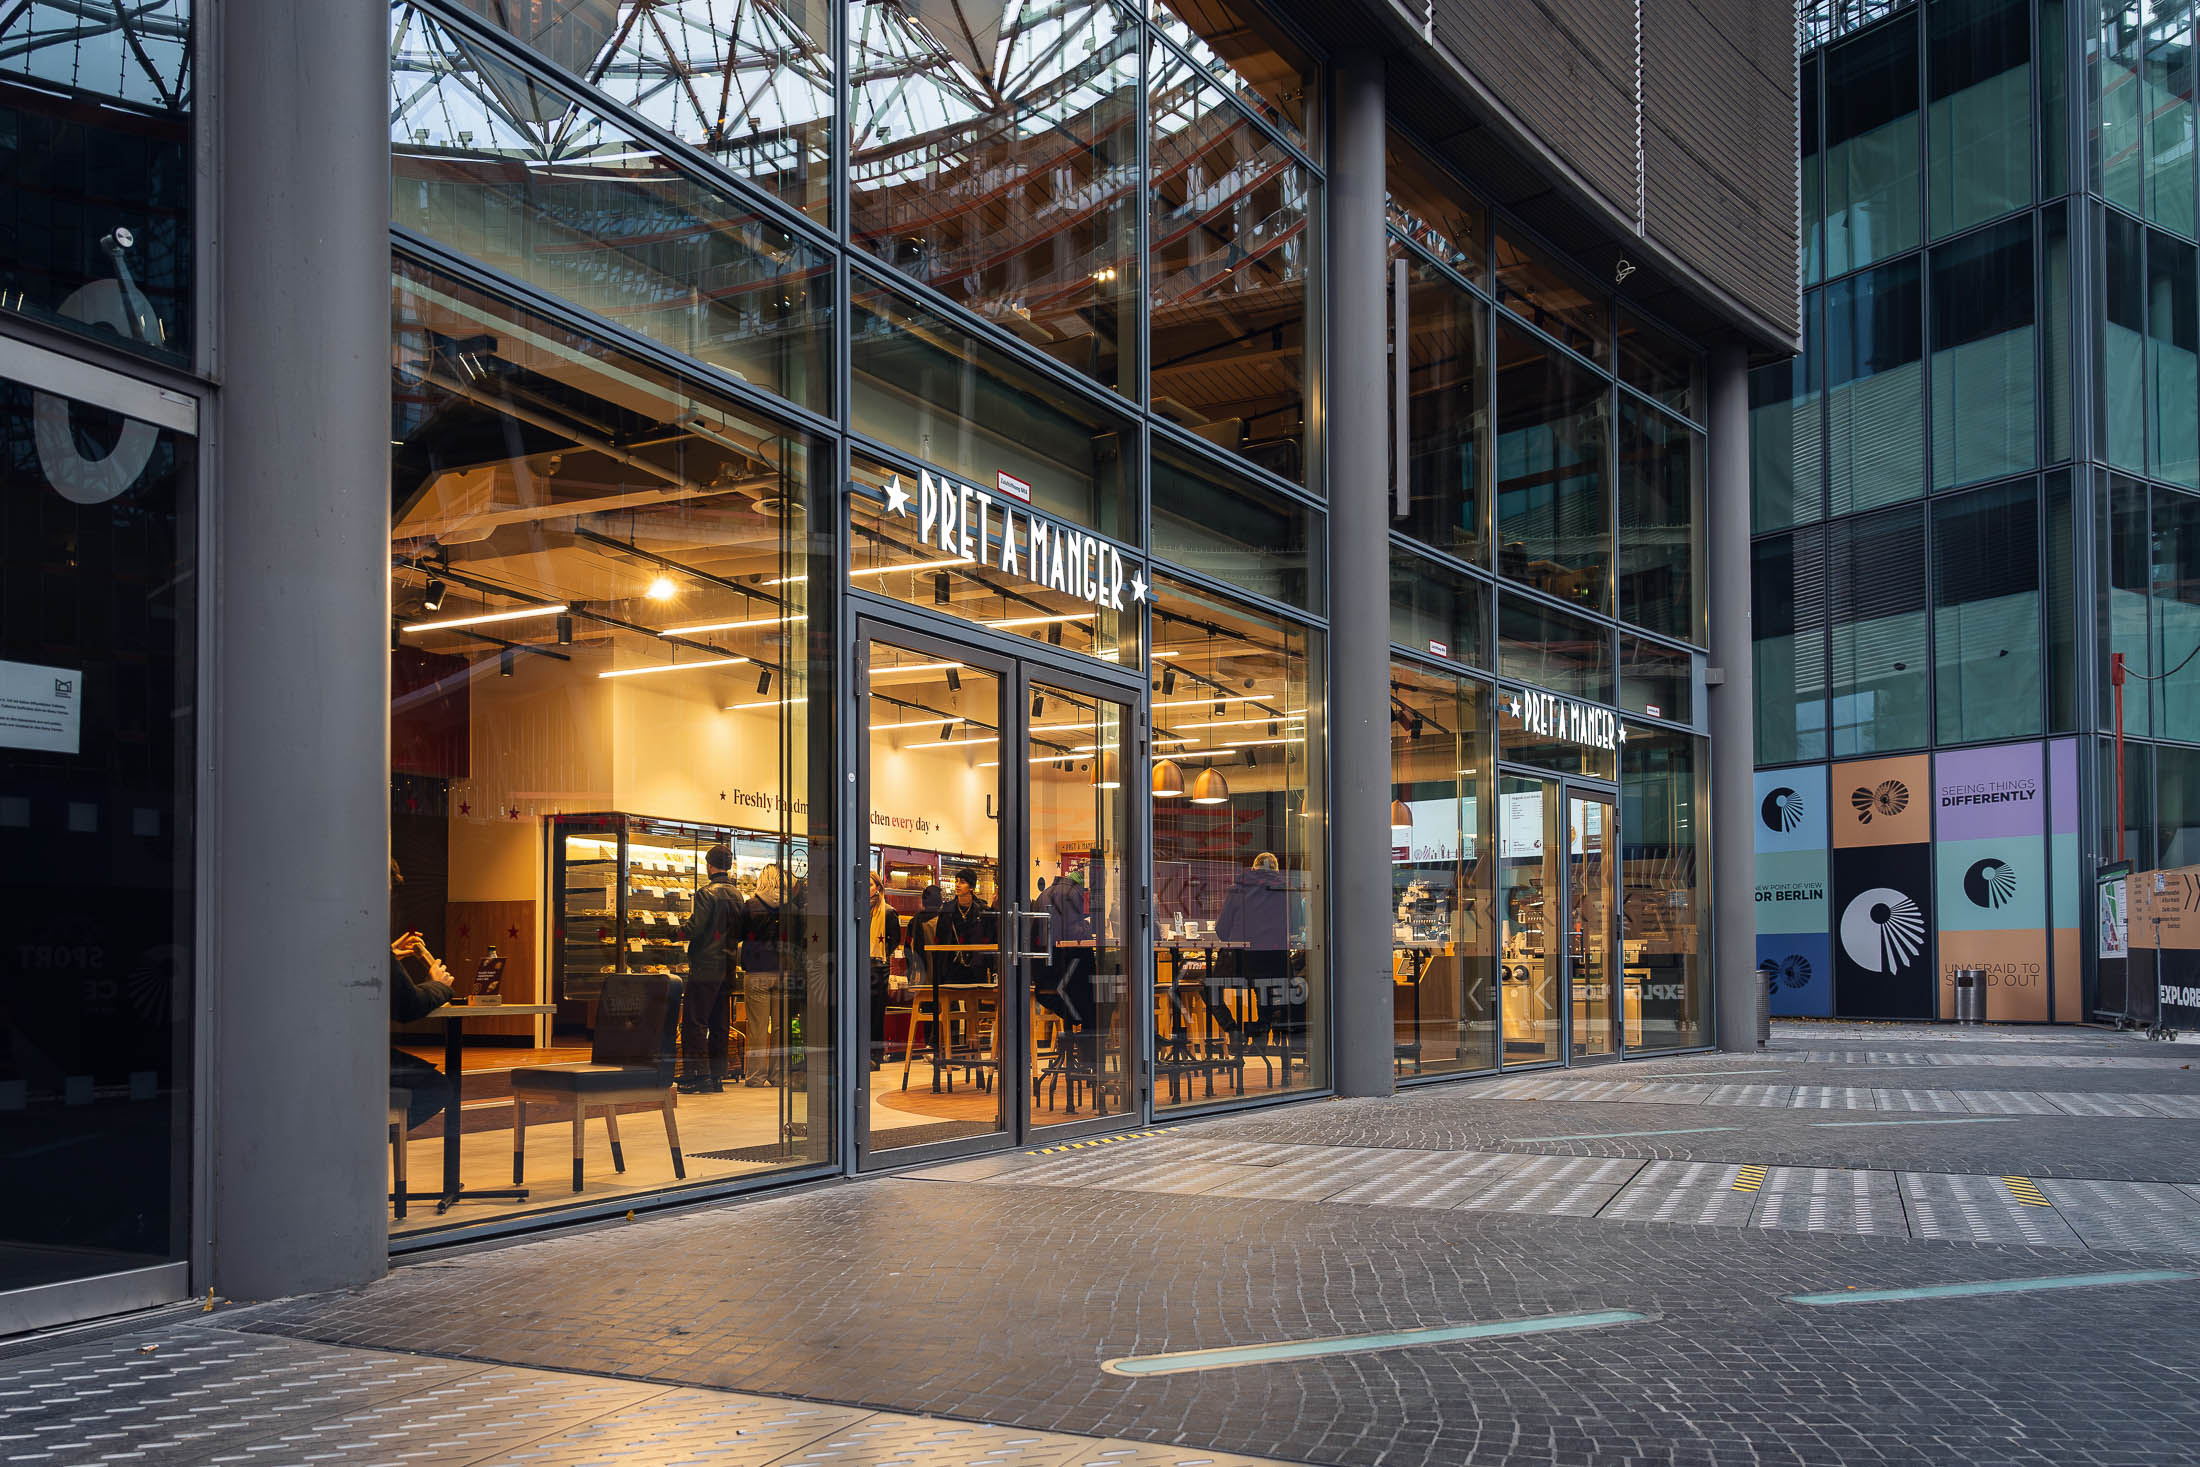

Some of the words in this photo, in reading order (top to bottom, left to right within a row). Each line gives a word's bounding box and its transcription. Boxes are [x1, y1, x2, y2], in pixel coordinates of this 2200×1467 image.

[918, 468, 992, 564] PRET
[1001, 506, 1019, 576] A
[1028, 513, 1124, 612] MANGER
[1523, 688, 1555, 737] PRET
[1558, 699, 1567, 740] A
[1569, 700, 1616, 751] MANGER
[1942, 783, 1985, 797] SEEING
[1989, 778, 2035, 792] THINGS
[1942, 789, 2036, 807] DIFFERENTLY
[733, 788, 774, 814] Freshly
[891, 816, 914, 833] every
[915, 816, 931, 835] day
[1770, 883, 1790, 891] POINT
[1792, 882, 1803, 890] OF
[1804, 881, 1823, 889] VIEW
[1754, 891, 1773, 902] OR
[1776, 889, 1823, 902] BERLIN
[1944, 963, 2017, 974] UNAFRAID
[2020, 963, 2041, 974] TO
[2004, 974, 2040, 987] OUT
[2160, 984, 2200, 1008] EXPLORE
